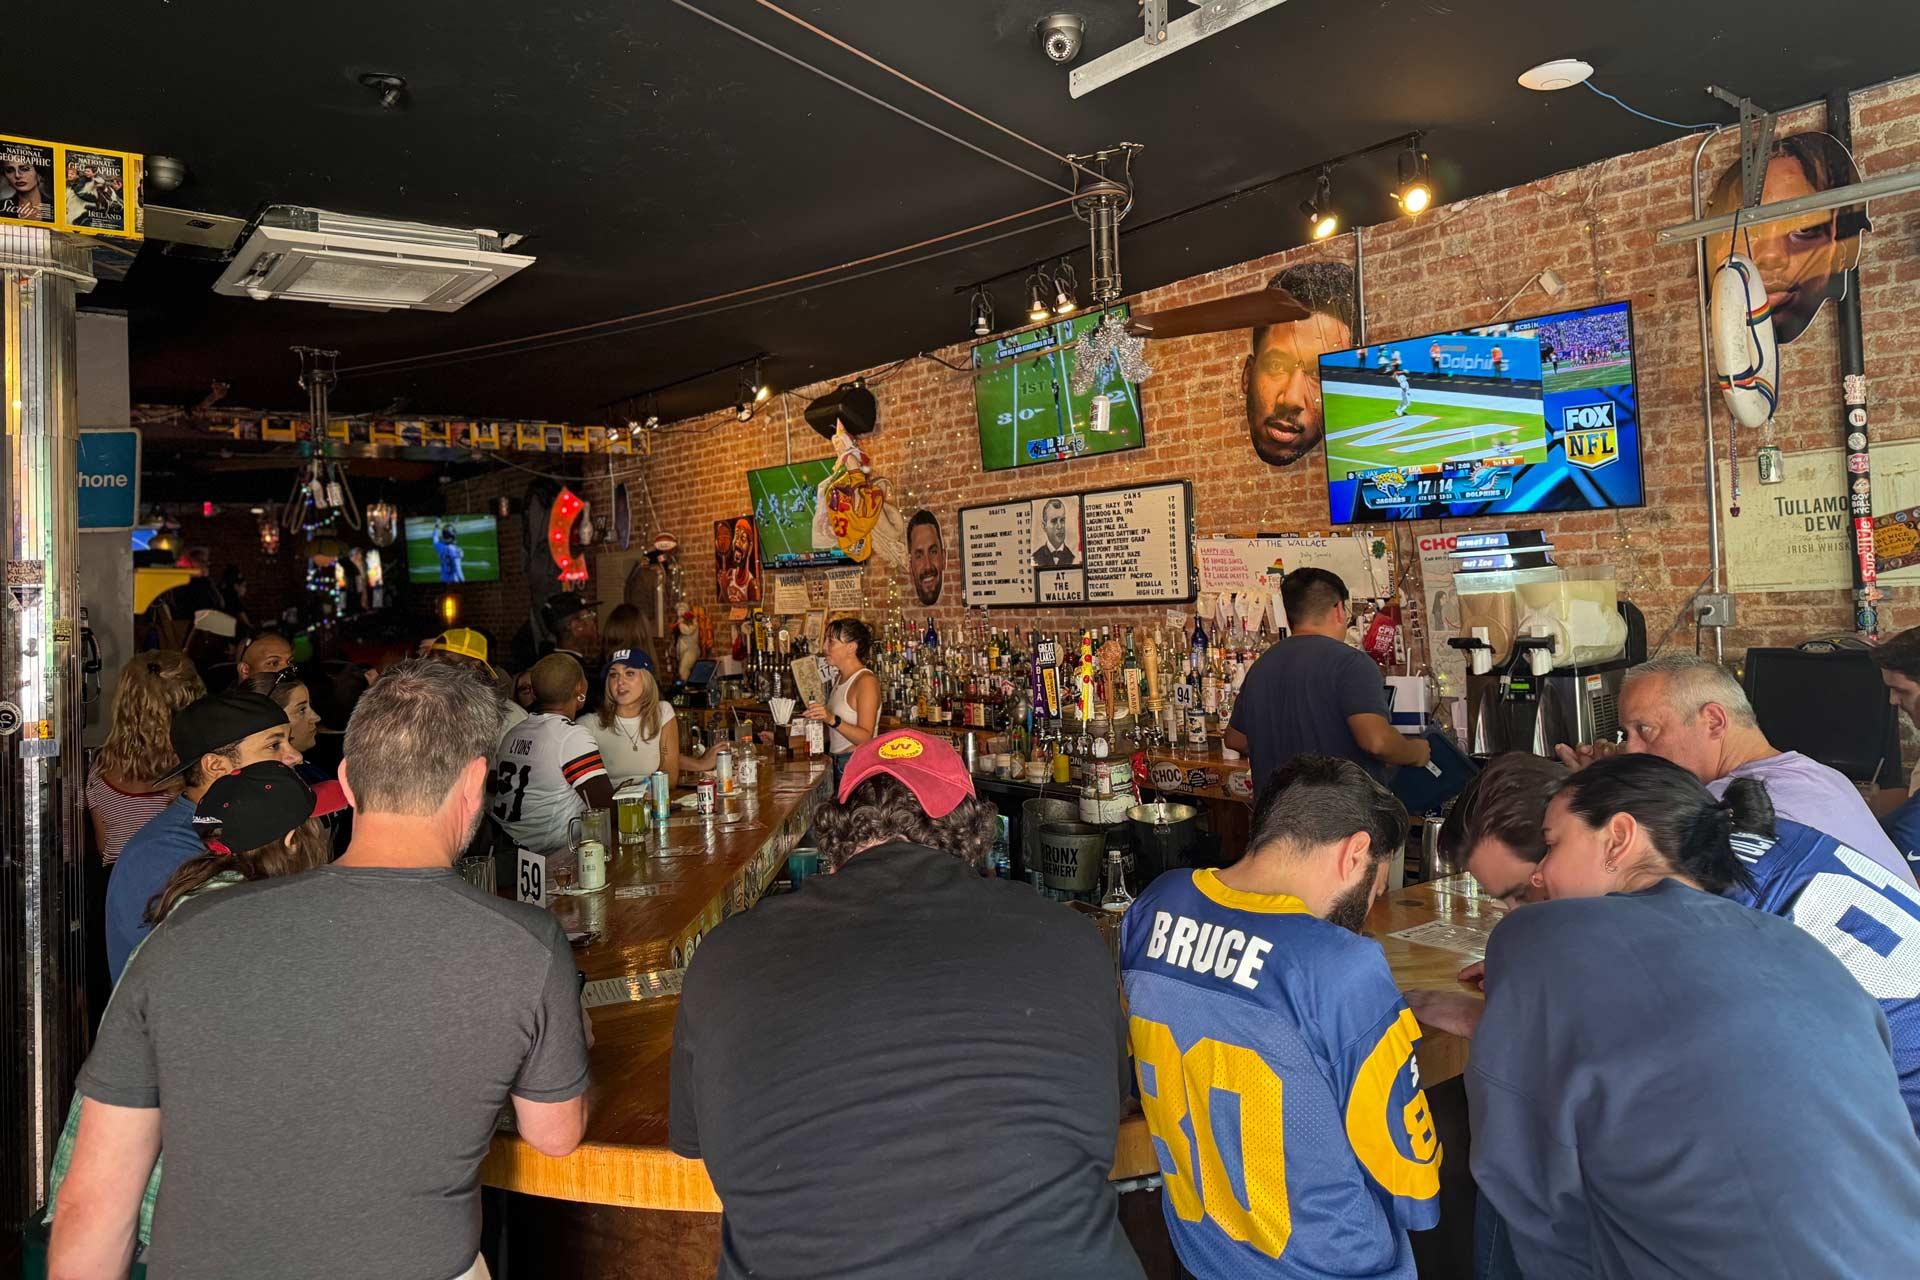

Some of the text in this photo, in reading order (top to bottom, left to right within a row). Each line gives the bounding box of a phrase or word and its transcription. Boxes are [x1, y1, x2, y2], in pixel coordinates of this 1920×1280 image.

[6, 147, 42, 158] NATIONAL
[0, 152, 51, 167] GEOGRAPHIC
[78, 158, 113, 168] NATIONAL
[68, 162, 121, 176] GEOAPHIC
[0, 200, 38, 219] Sicily
[88, 210, 122, 221] IRELAND
[1438, 352, 1511, 373] Dolphis
[1021, 383, 1045, 395] 1ST
[1566, 405, 1613, 431] FOX
[1569, 431, 1614, 457] NFL
[77, 472, 128, 487] hone
[1418, 478, 1453, 494] 17 14
[1123, 492, 1142, 500] CANS
[1465, 490, 1501, 498] DOLPHINS
[1085, 503, 1102, 511] STONE
[1105, 501, 1120, 509] HAZY
[1774, 496, 1848, 516] TULLAMO
[1853, 507, 1870, 515] NYC
[1804, 514, 1842, 532] DEW
[1087, 531, 1115, 539] LAGUNITAS
[1484, 536, 1499, 545] Ice
[1247, 539, 1328, 548] AT THE WALLACE
[1787, 543, 1814, 554] IRISH
[1056, 571, 1065, 580] AT
[1130, 572, 1153, 580] PACIFICO
[1053, 581, 1069, 591] THE
[1089, 582, 1109, 590] TECATE
[1136, 580, 1162, 588] MEDALLA
[1045, 591, 1081, 601] WALLACE
[1037, 643, 1054, 653] GREAT
[1039, 652, 1056, 662] LAKES
[1035, 657, 1043, 701] ABITA
[1176, 686, 1191, 704] 94
[509, 738, 533, 756] LYONS
[1152, 768, 1181, 783] CHOC
[698, 791, 712, 802] IPA
[520, 858, 541, 901] 59
[1145, 910, 1274, 991] BRUCE
[1127, 1013, 1293, 1260] 80
